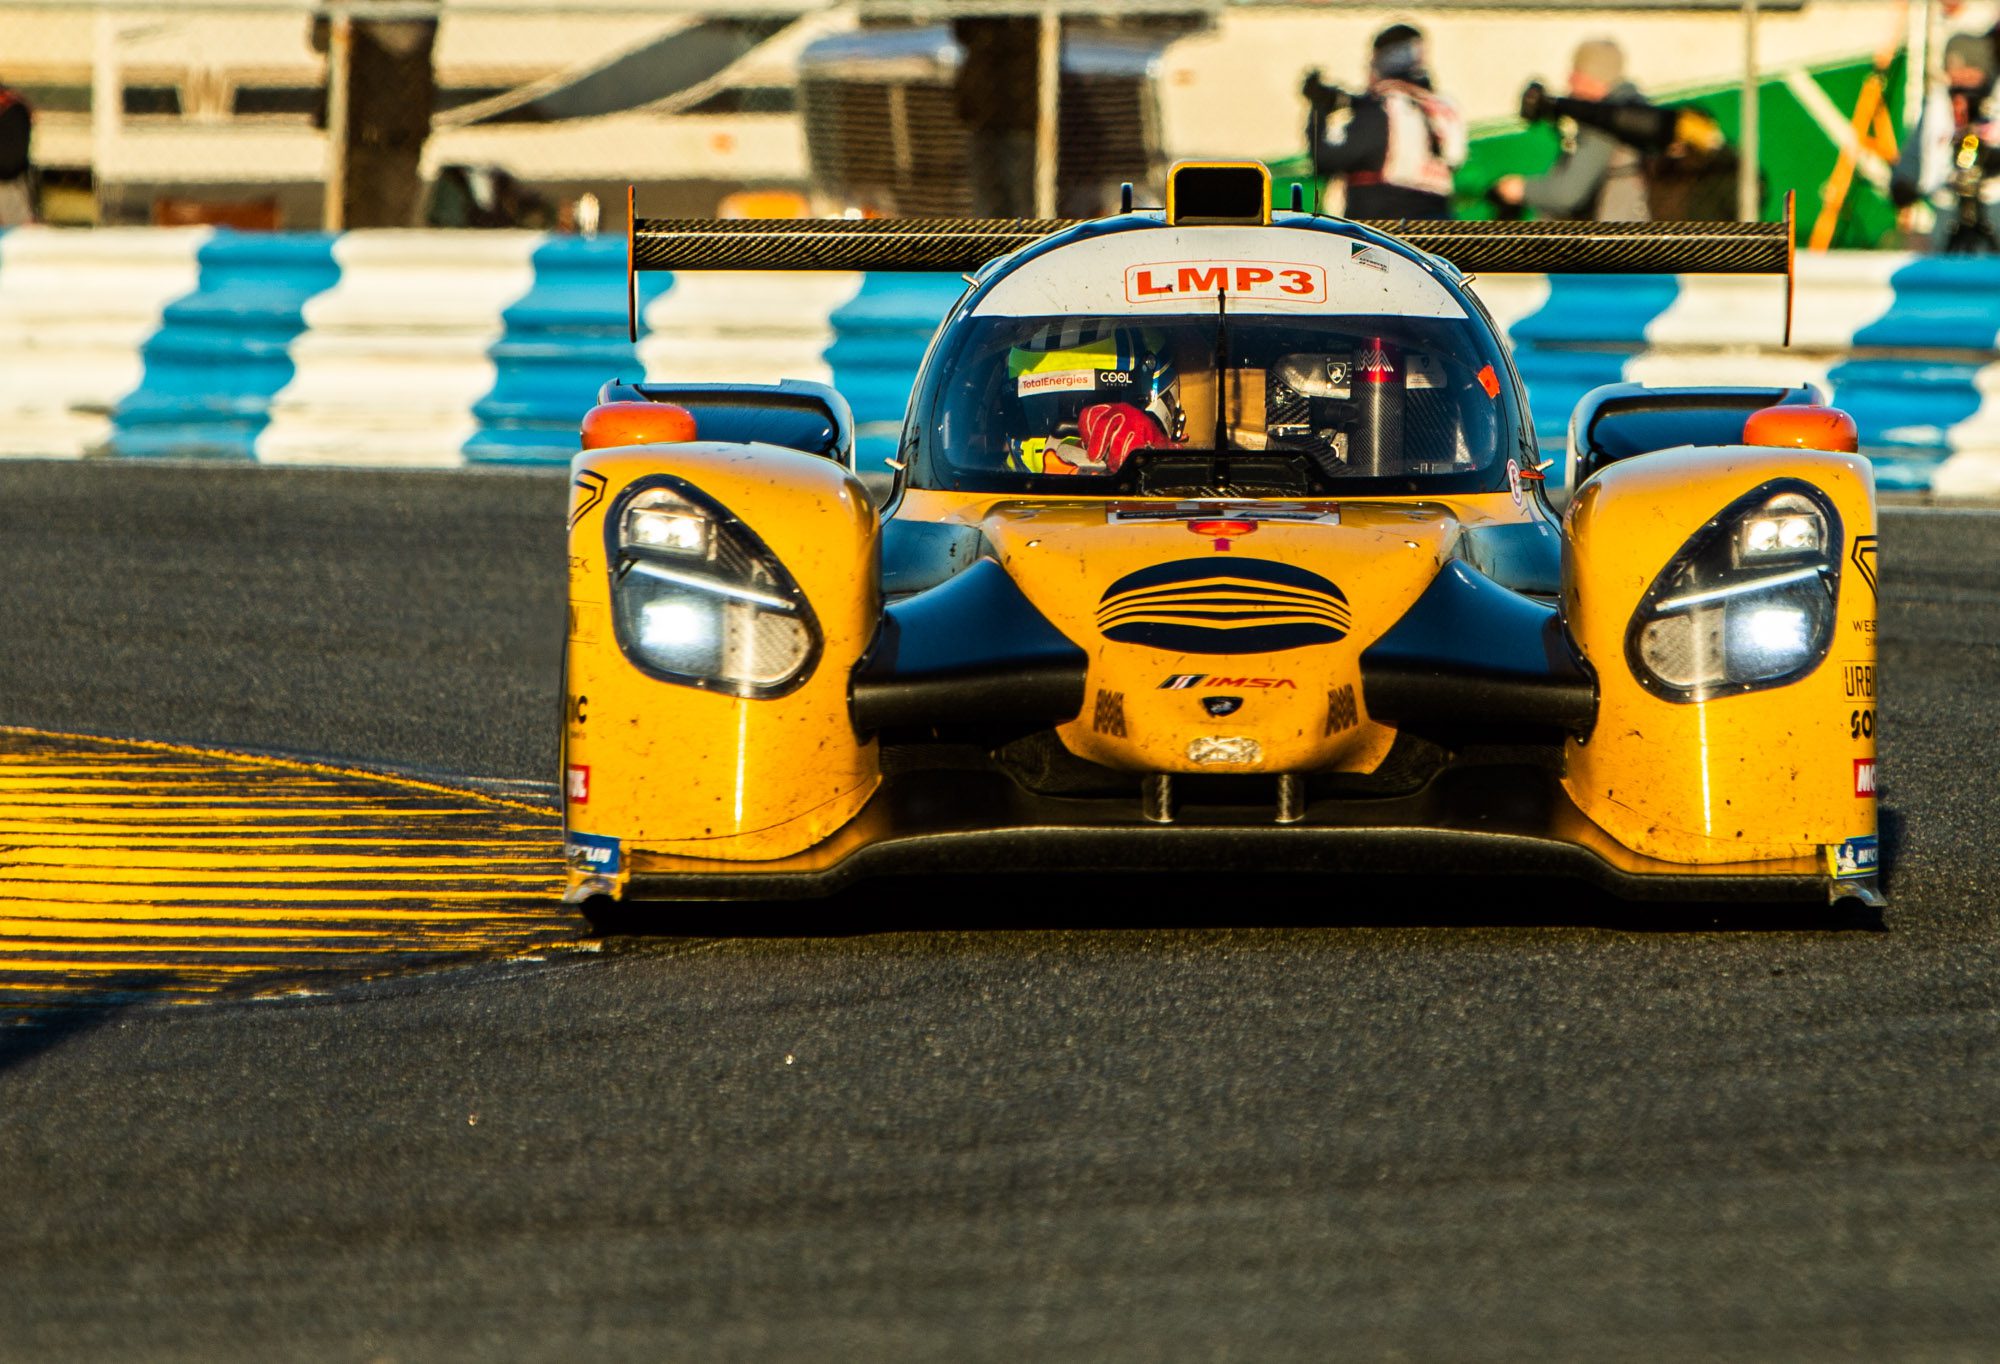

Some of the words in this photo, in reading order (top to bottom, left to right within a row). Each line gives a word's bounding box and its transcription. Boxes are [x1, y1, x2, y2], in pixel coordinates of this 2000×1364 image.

[1137, 267, 1315, 295] LMP3
[1022, 375, 1088, 389] TotalEnergies
[1100, 372, 1133, 383] COOL
[1204, 677, 1297, 690] IMSA
